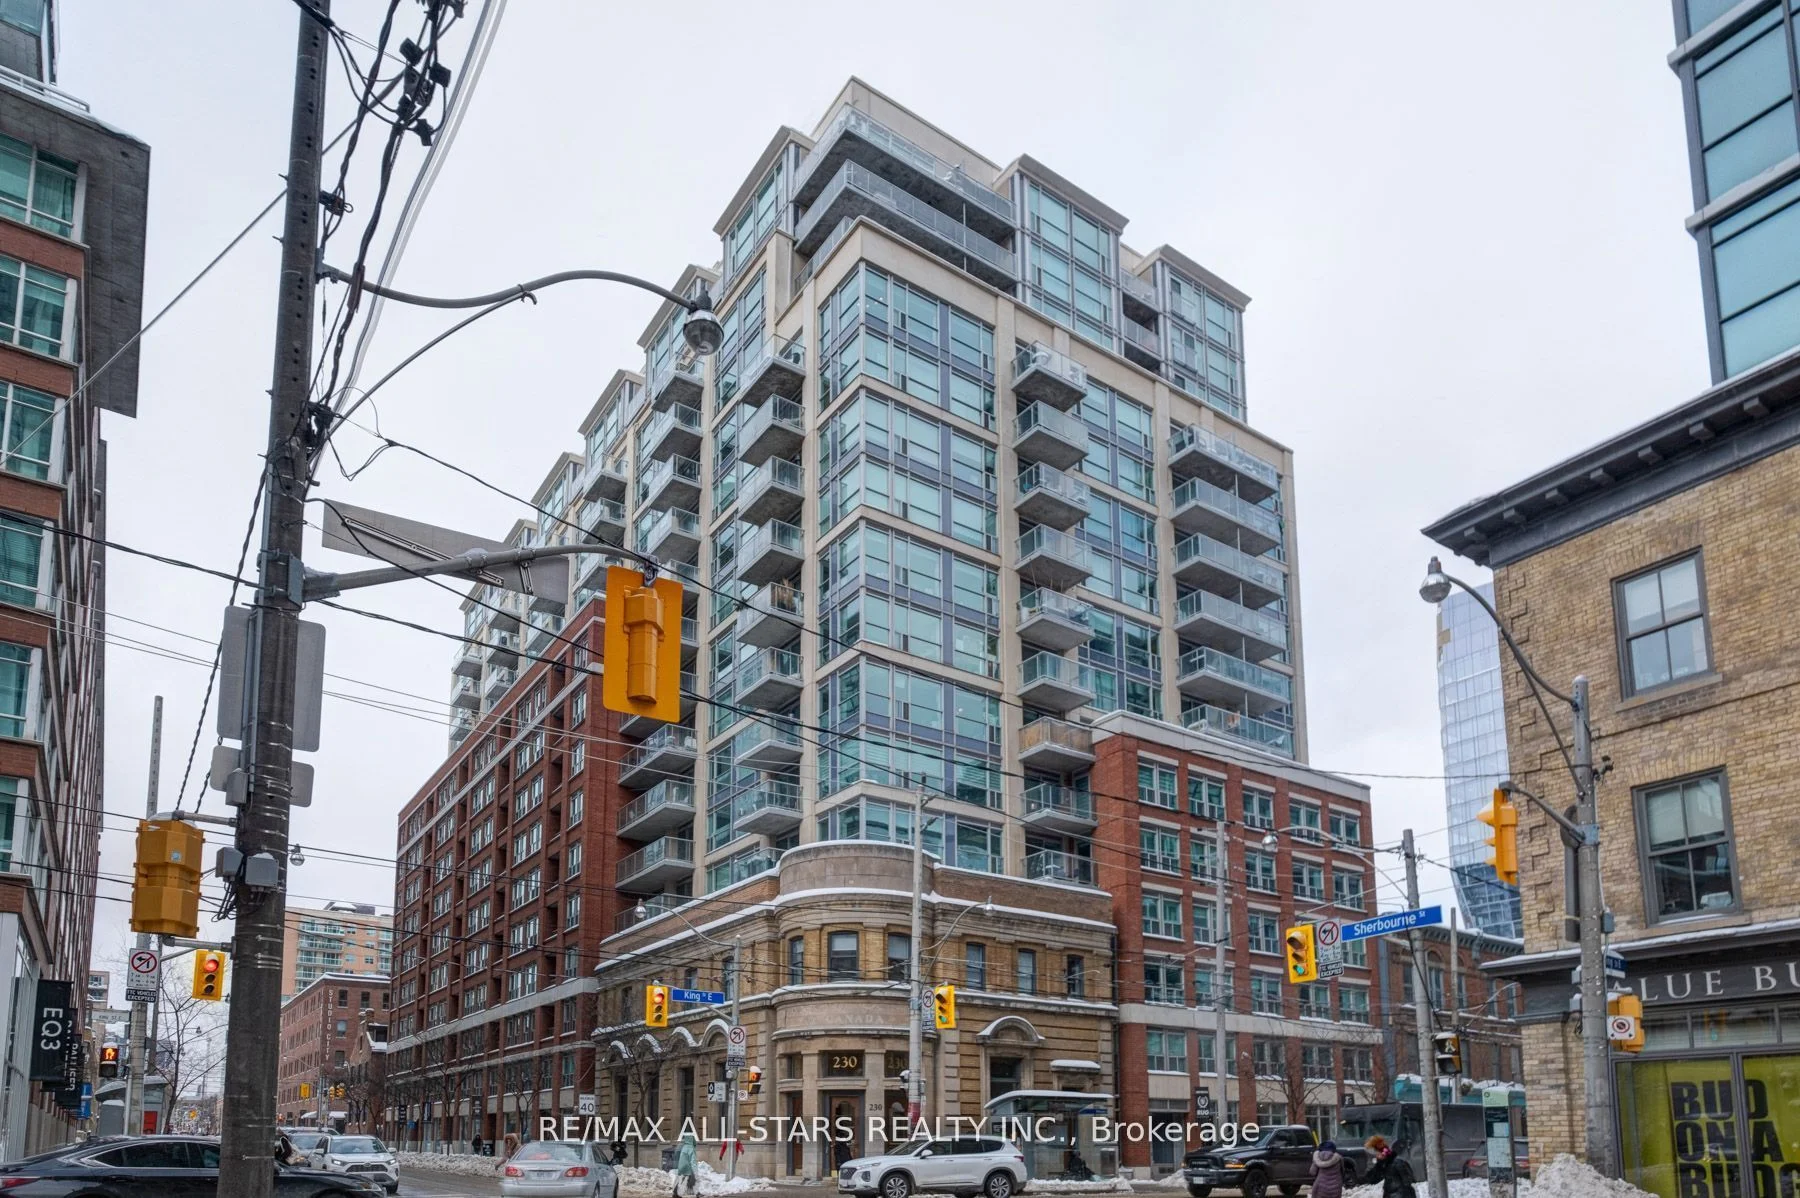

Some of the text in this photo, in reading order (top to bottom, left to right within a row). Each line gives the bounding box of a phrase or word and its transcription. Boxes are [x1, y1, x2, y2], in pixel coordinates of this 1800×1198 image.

[1354, 914, 1417, 936] Sherbourne
[684, 991, 701, 1002] King
[707, 993, 713, 1001] E
[41, 1007, 63, 1051] EQ3
[832, 1056, 858, 1069] 230
[1671, 1079, 1769, 1120] BUD
[580, 1103, 595, 1113] 40
[869, 1104, 882, 1112] 230
